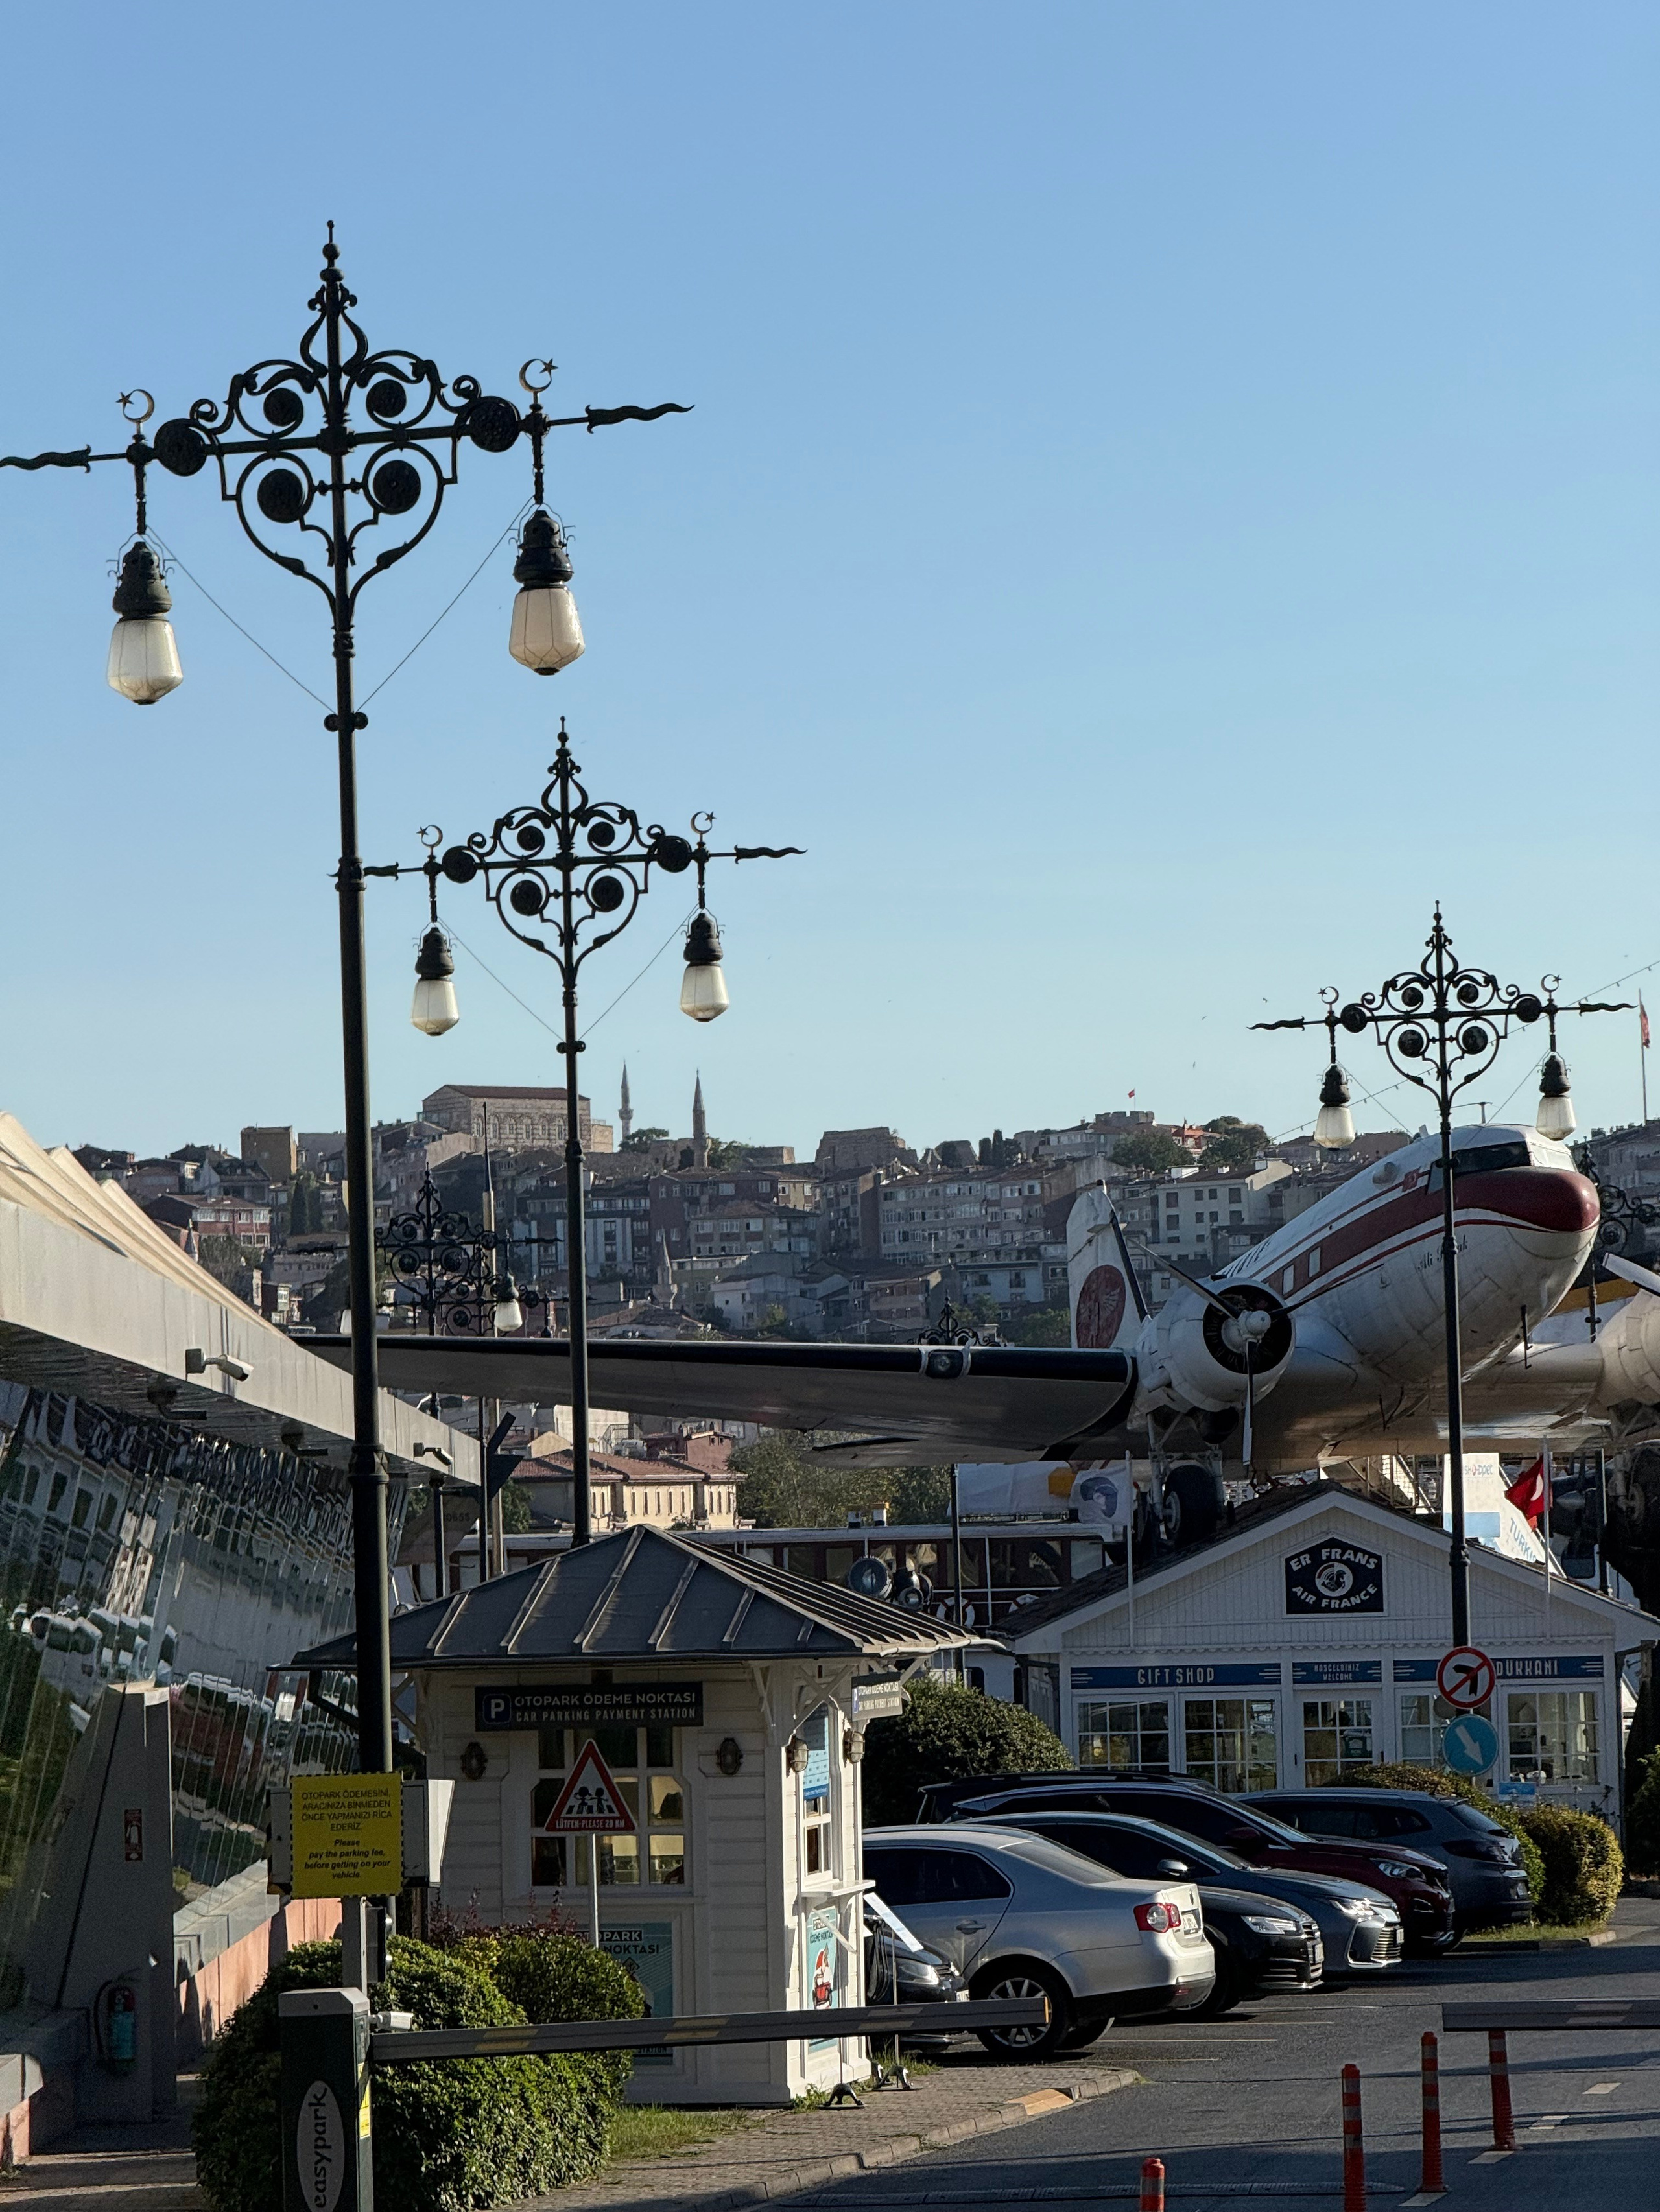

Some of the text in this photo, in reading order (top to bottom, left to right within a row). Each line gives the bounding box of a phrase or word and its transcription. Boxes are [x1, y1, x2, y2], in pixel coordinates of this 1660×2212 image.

[1290, 1548, 1379, 1571] ER FRANS
[1292, 1583, 1378, 1608] AIR FRANCE
[1137, 1667, 1214, 1684] GIFT SHOP
[1323, 1673, 1353, 1681] WELCOME
[514, 1692, 695, 1706] OTOPARK ÖDEME NOKTASI
[516, 1707, 695, 1722] CAR PARKING PAYMENT STATION
[302, 1791, 341, 1800] OTOPARK
[302, 1810, 392, 1821] ÖNCE YAPMANIZI RİCA
[605, 1819, 613, 1828] 20
[334, 1839, 361, 1847] Please
[309, 1852, 323, 1860] pay
[339, 1849, 370, 1859] parking
[304, 1861, 329, 1870] before
[331, 1860, 358, 1870] getting
[372, 1860, 391, 1868] your
[575, 1931, 641, 1941] OTPARK
[604, 1944, 659, 1955] NOKTASI
[308, 2087, 332, 2208] easypark
